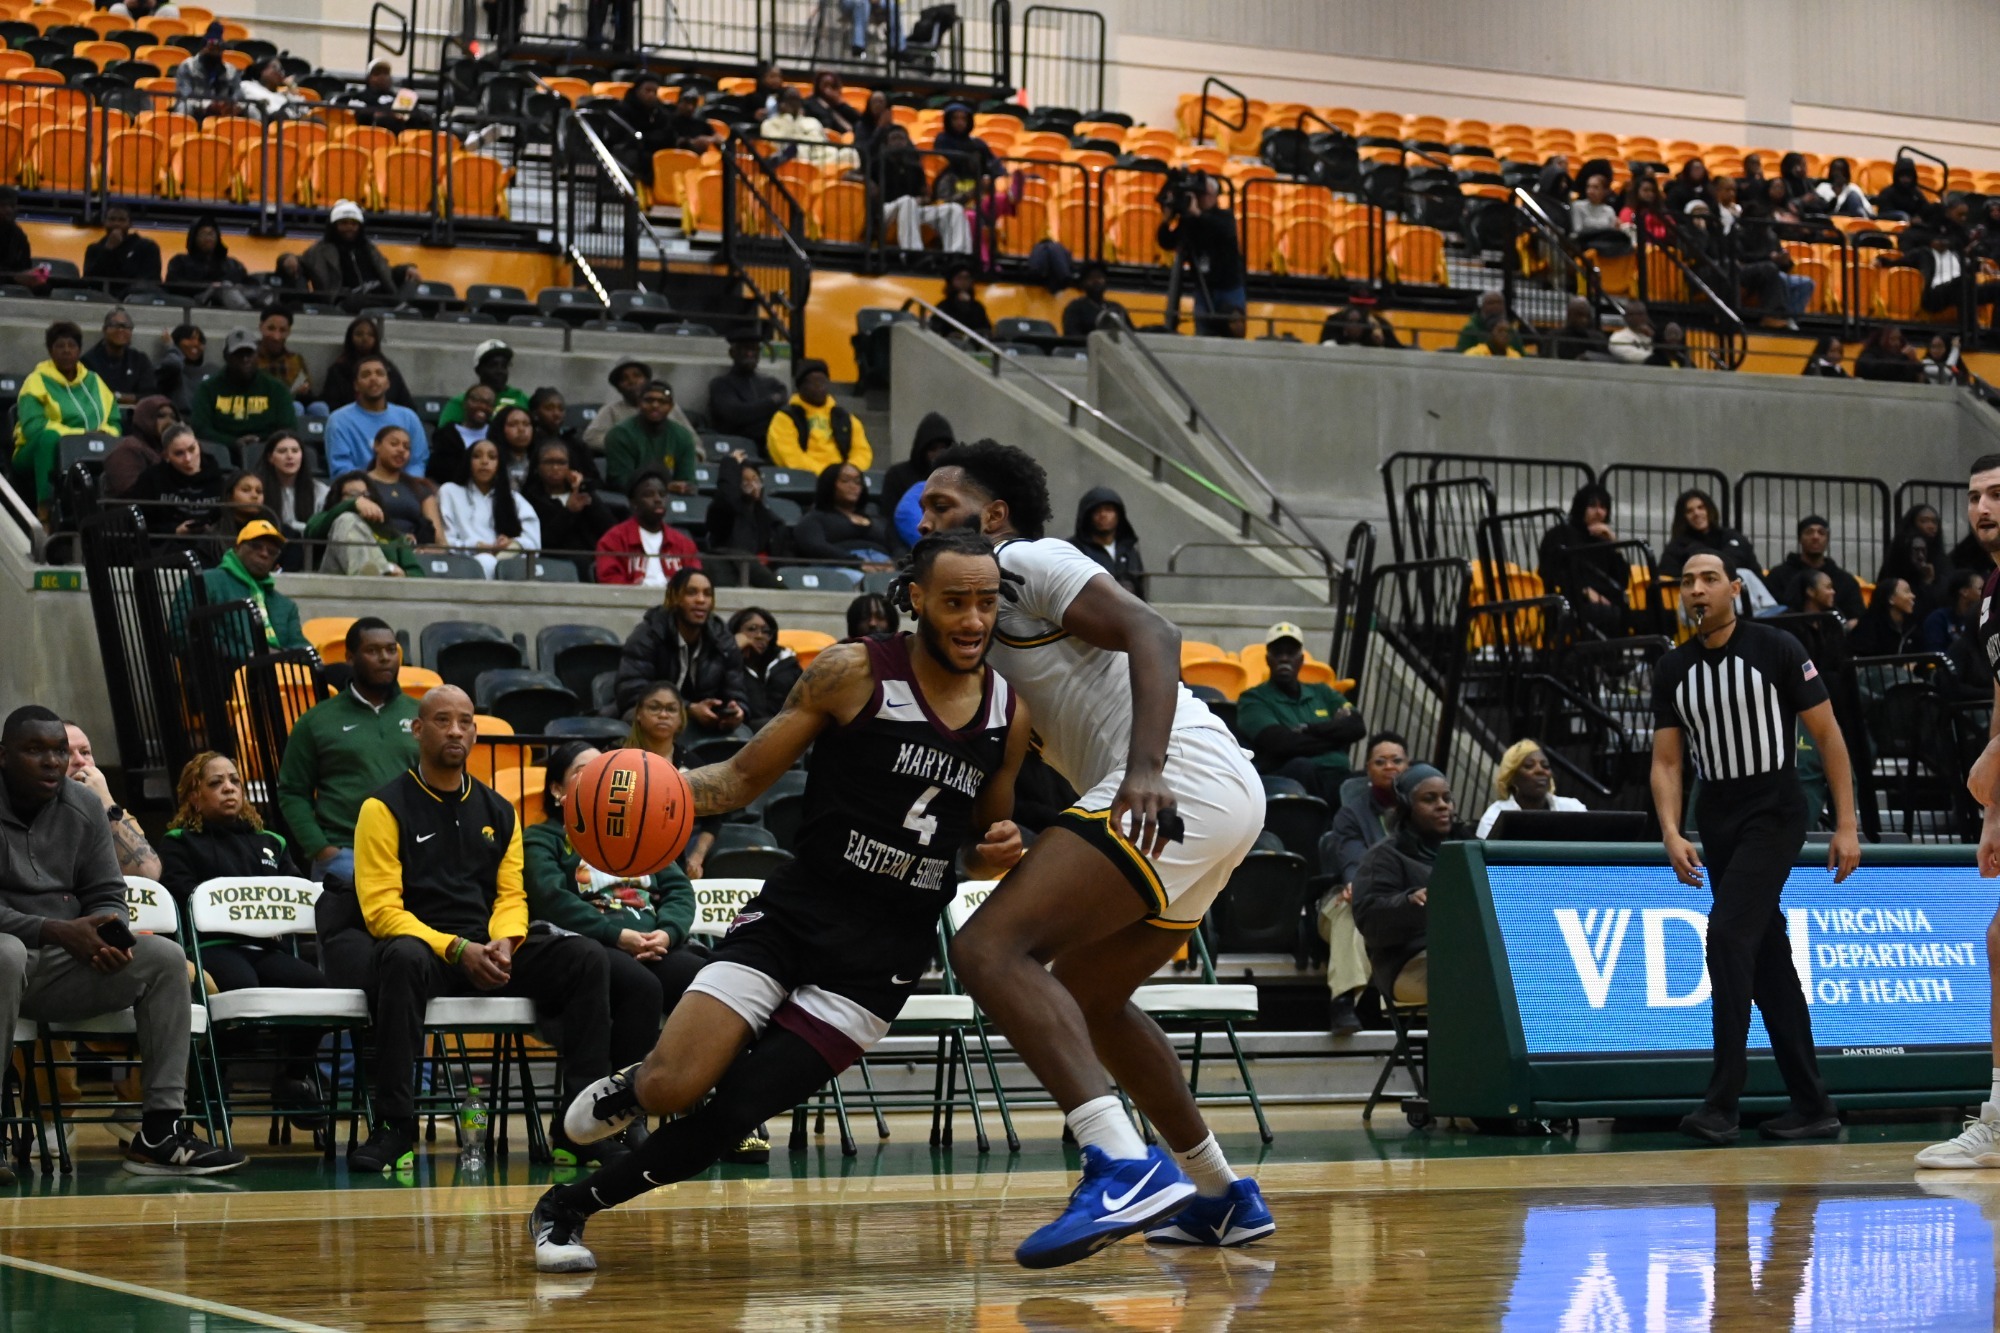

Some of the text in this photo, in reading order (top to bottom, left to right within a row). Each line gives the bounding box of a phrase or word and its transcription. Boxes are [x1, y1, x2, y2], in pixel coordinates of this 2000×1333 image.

[892, 742, 985, 798] MARYLAND
[606, 769, 632, 837] ELITE
[902, 785, 938, 846] 4
[843, 829, 949, 890] EASTERN SHORE
[209, 886, 315, 907] NORFOLK
[228, 904, 297, 921] STATE
[1811, 908, 1933, 934] VIRGINIA
[1816, 943, 1977, 968] DEPARTMENT
[1817, 978, 1954, 1004] OF HEALTH
[1842, 1046, 1905, 1056] DAKTRONICS
